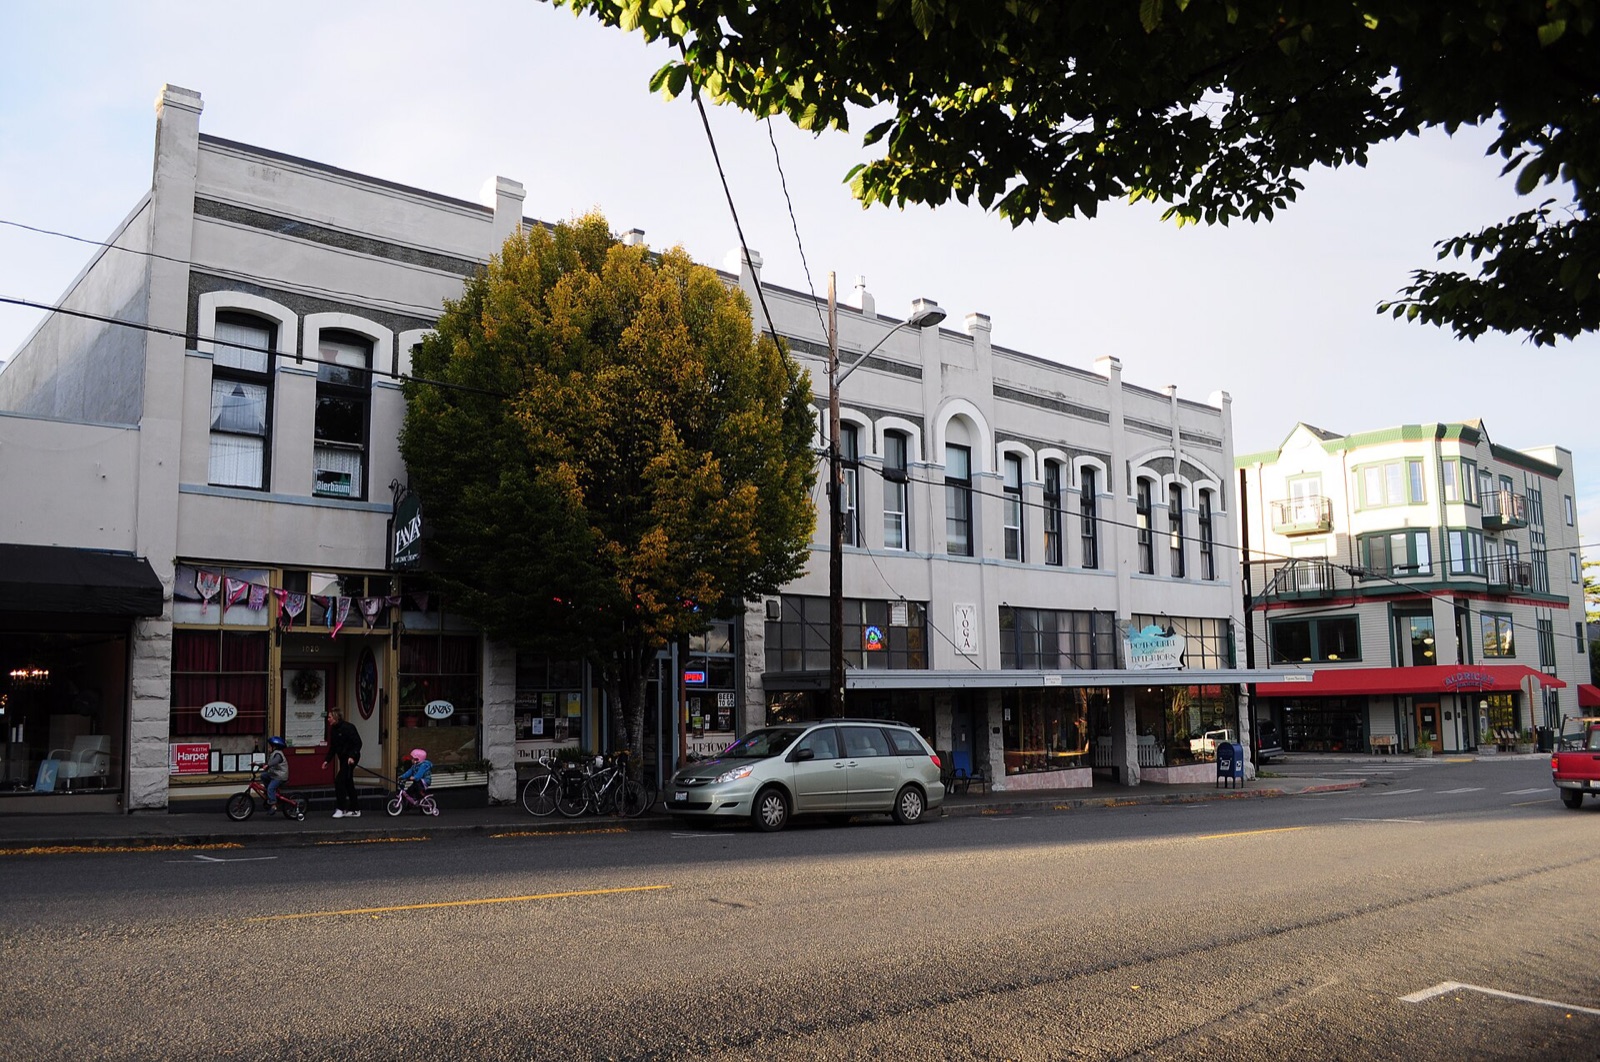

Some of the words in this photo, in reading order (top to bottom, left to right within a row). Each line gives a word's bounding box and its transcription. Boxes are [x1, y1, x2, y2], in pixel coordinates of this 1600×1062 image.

[316, 481, 350, 493] Bierbaum
[962, 609, 970, 648] YOGA
[684, 673, 702, 681] PEN
[205, 706, 234, 717] LANZA'S
[177, 752, 209, 762] Harper
